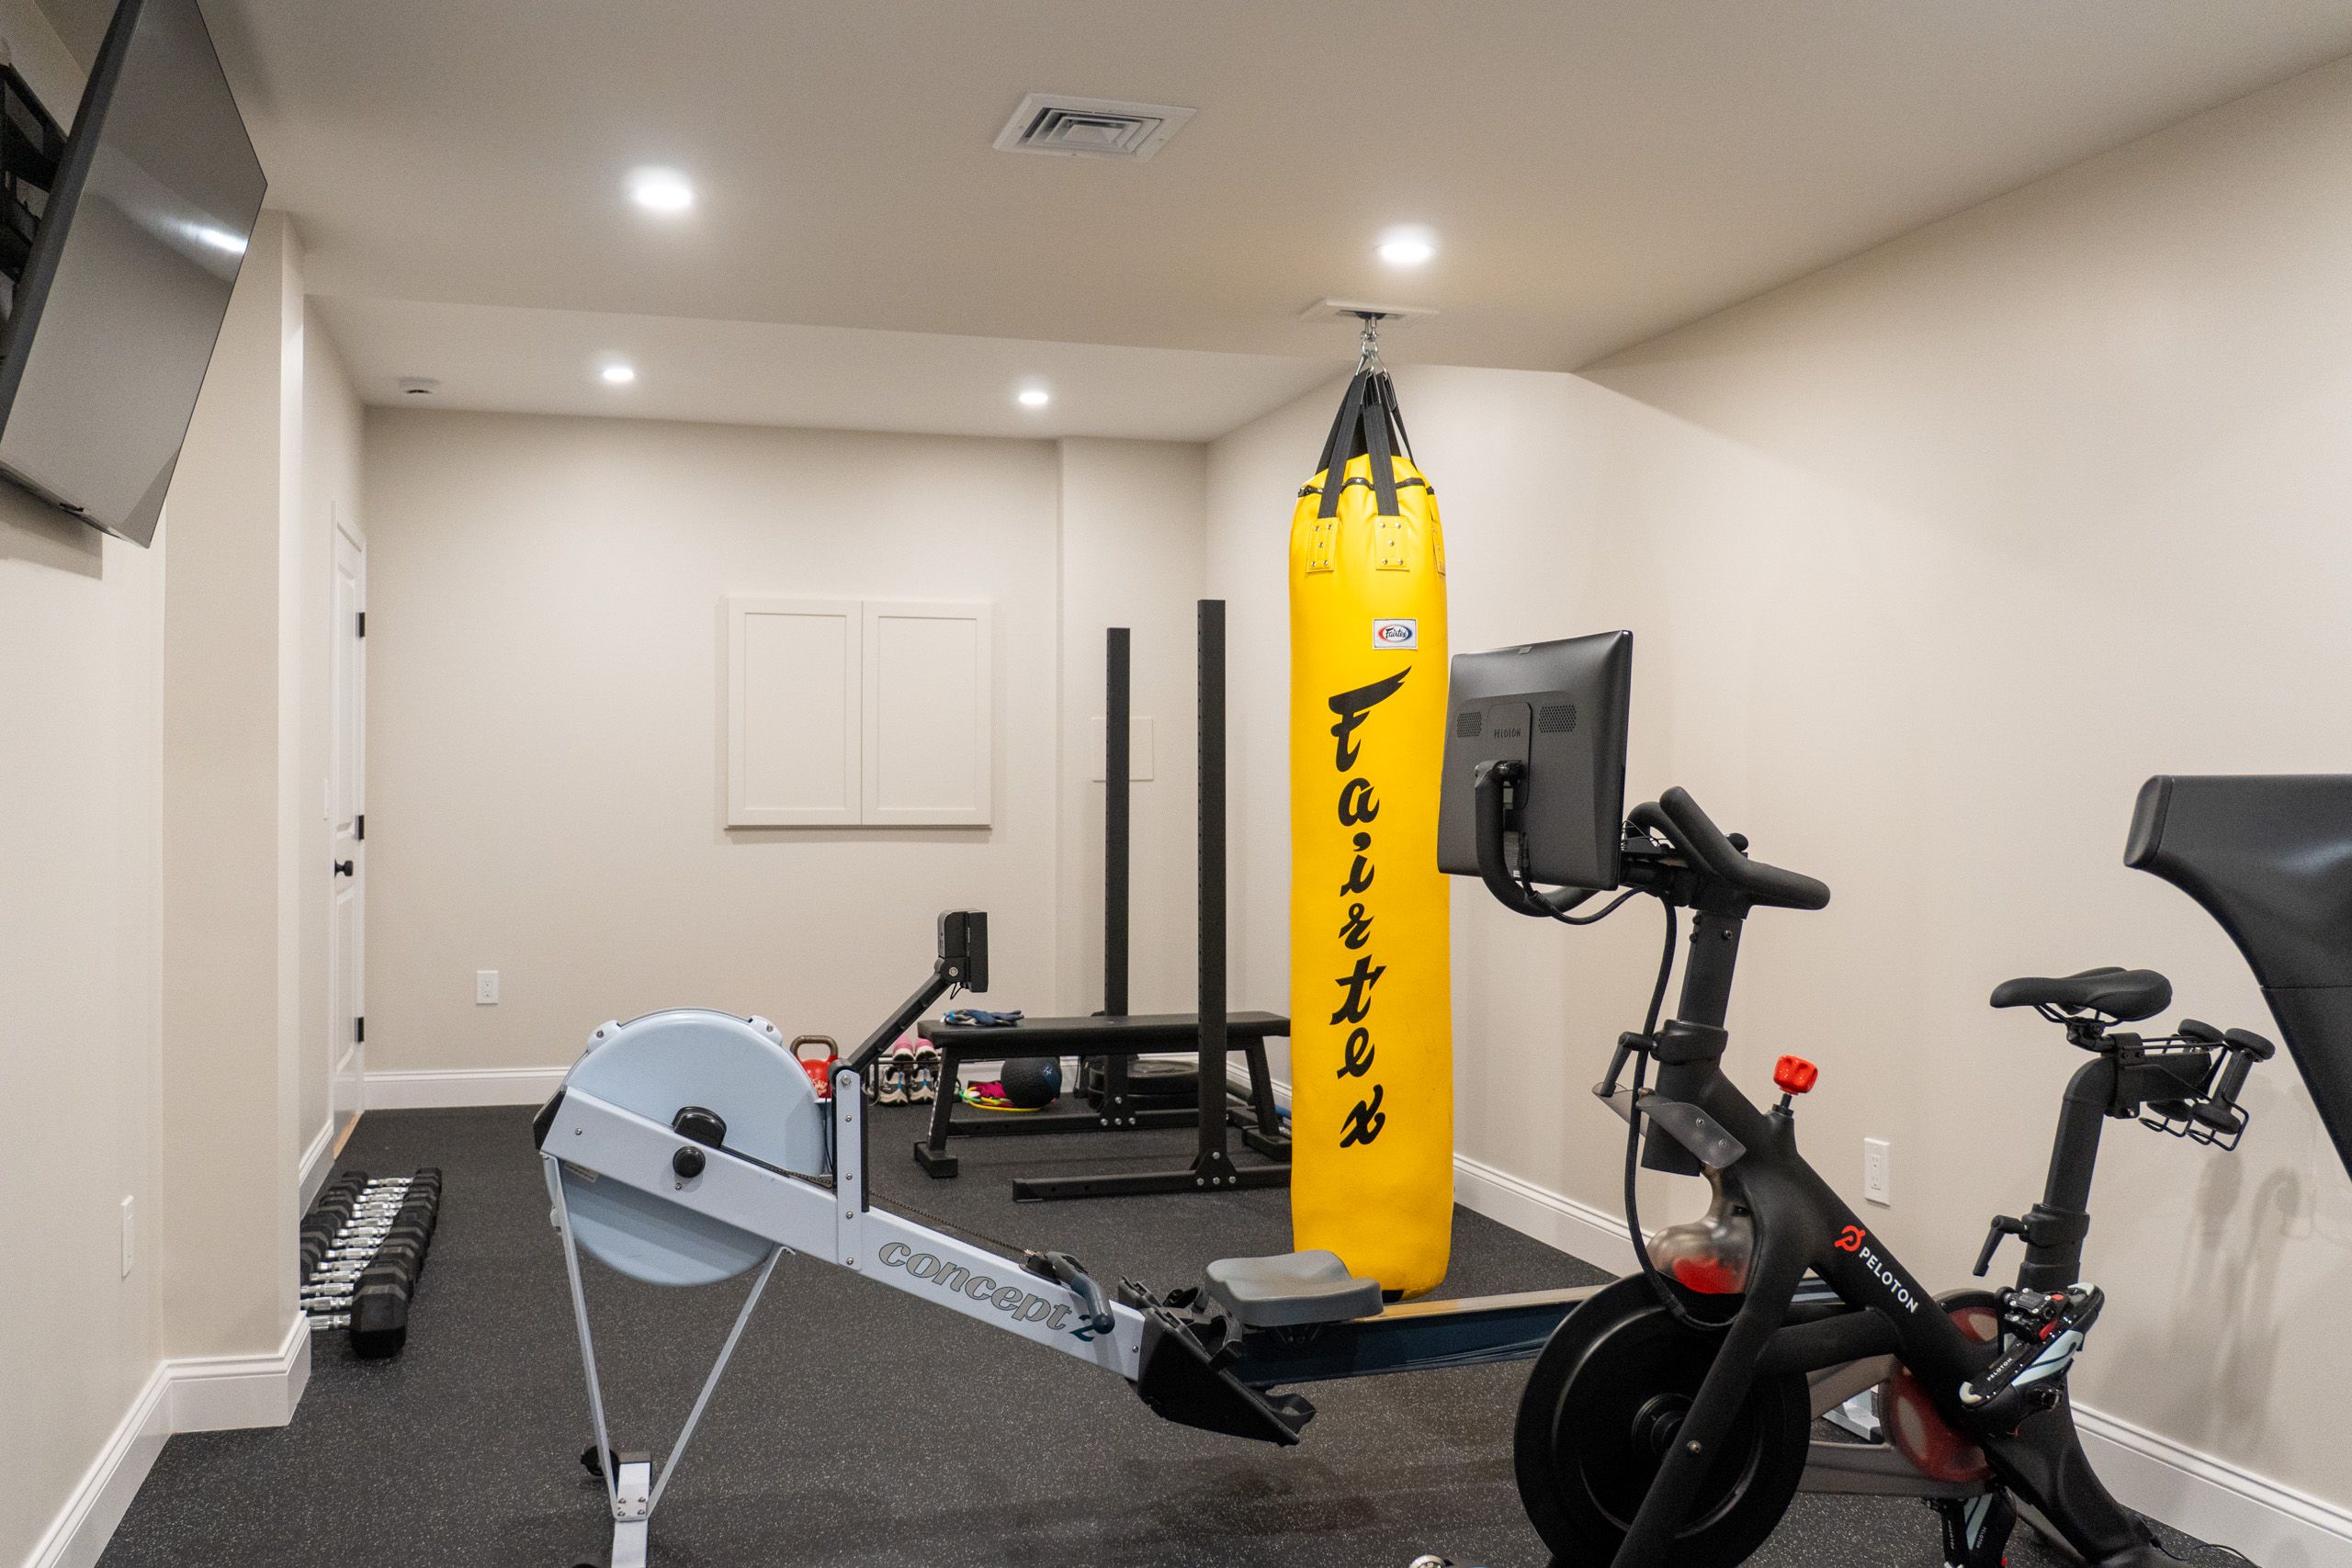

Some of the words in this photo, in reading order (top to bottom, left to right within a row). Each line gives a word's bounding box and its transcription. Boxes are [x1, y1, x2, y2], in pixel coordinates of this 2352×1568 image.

[1329, 666, 1412, 1148] Fairtex
[1859, 1246, 1919, 1314] PELOTON
[1986, 1357, 2013, 1382] PELOTON
